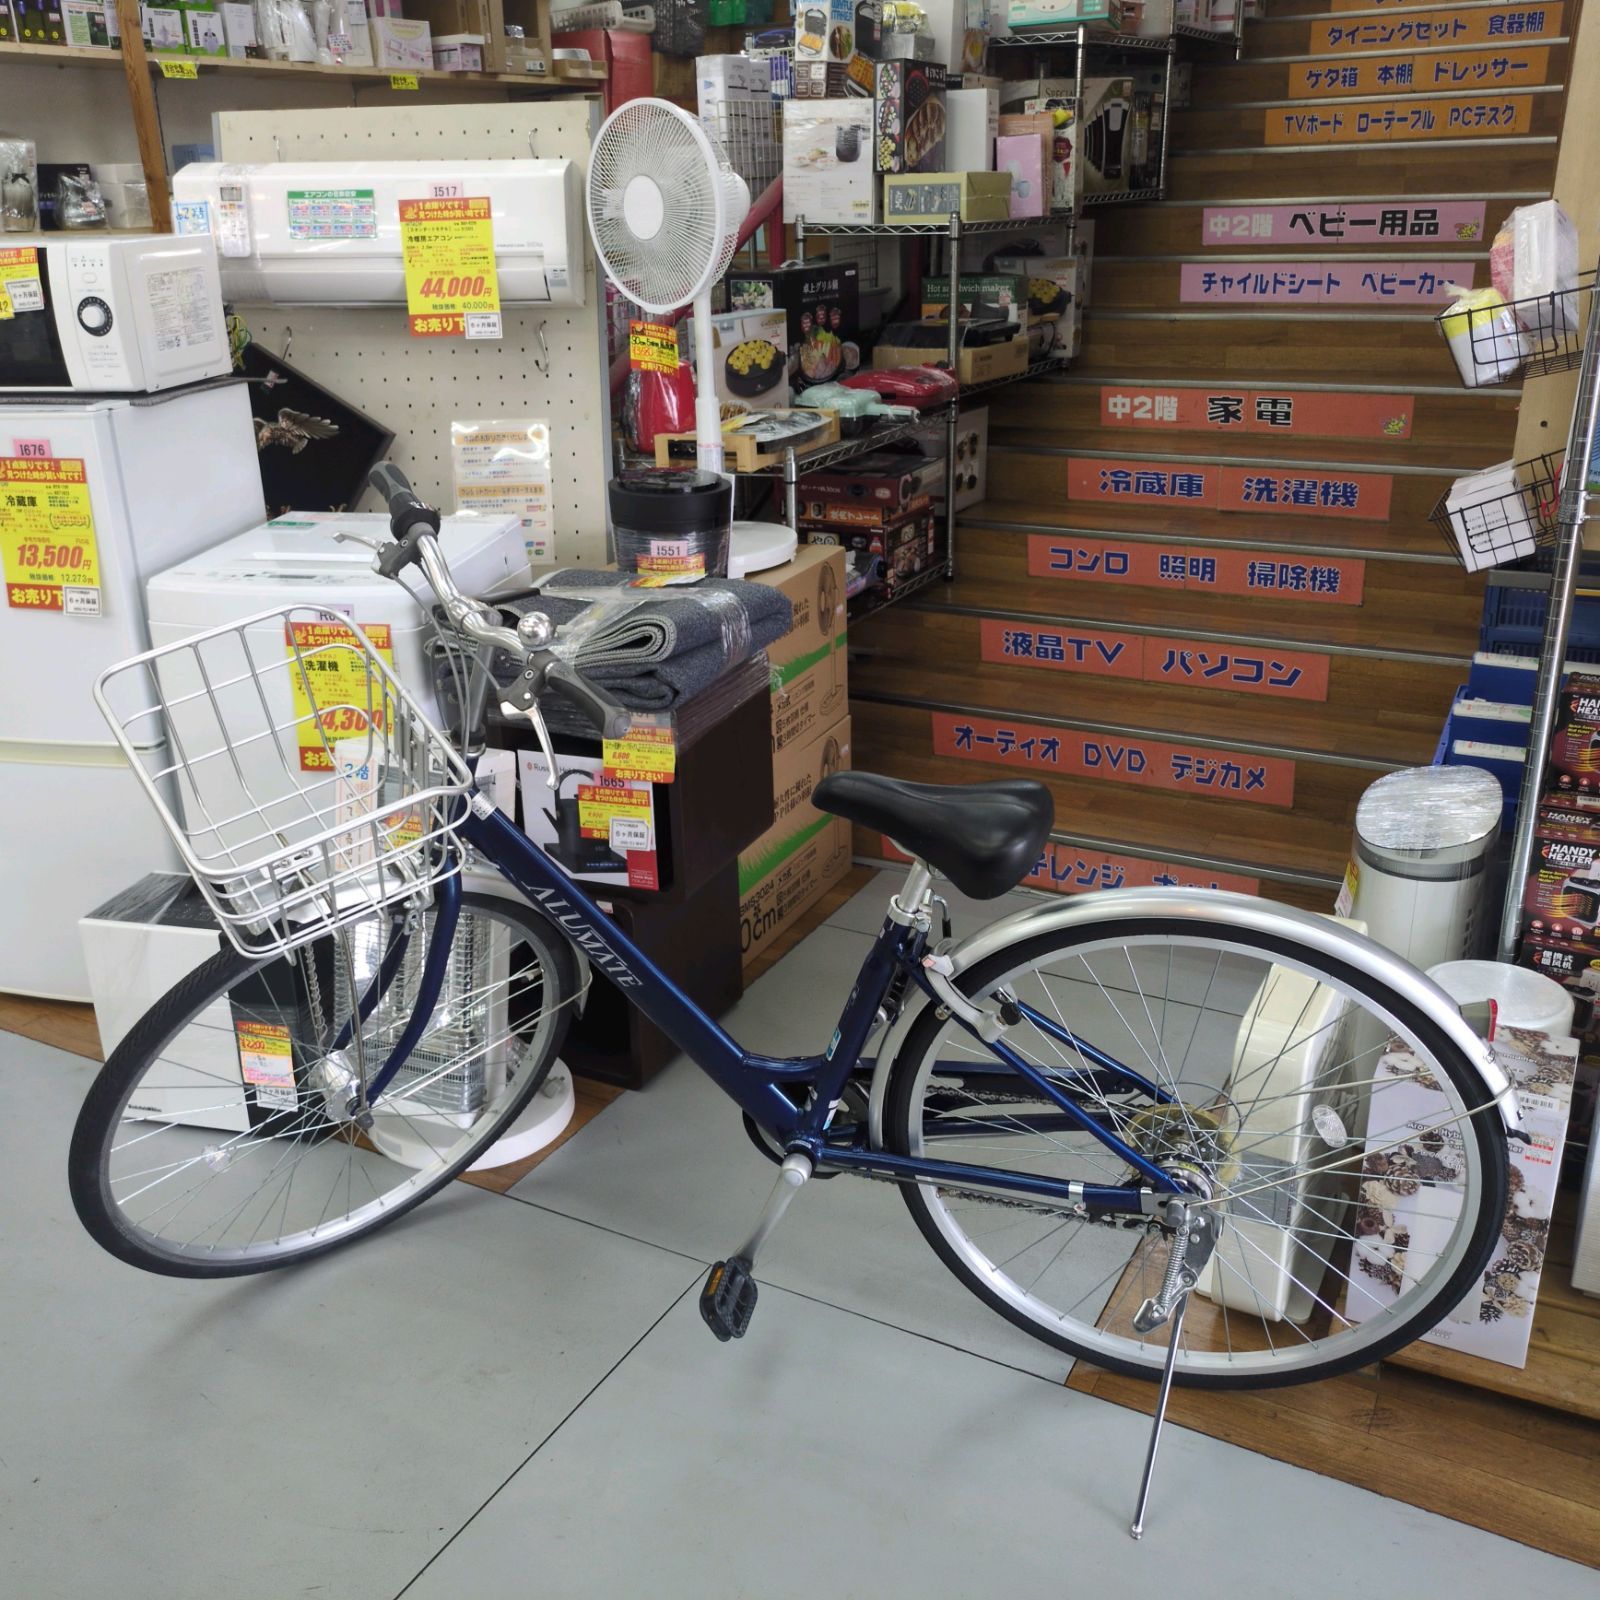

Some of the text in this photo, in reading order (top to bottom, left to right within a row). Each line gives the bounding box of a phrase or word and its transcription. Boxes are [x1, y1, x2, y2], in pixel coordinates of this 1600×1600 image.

[1487, 11, 1545, 36] 食器棚
[1305, 58, 1529, 89] ゲタ箱 本棚 ドレッサー
[1208, 209, 1439, 238] 中2階 ベビー用品
[419, 275, 493, 300] 44,000円
[927, 284, 941, 293] Hot
[1201, 271, 1341, 296] チャイルドシート
[1107, 394, 1294, 427] 中2階 家電
[5, 495, 38, 507] 冷蔵庫
[1099, 470, 1360, 508] 冷蔵庫 洗濯機
[17, 543, 92, 571] 13,500円
[1048, 546, 1341, 594] コンロ 照明 掃除機
[305, 660, 340, 672] 洗濯機
[1002, 630, 1303, 688] 液晶TV パソコン
[953, 724, 1267, 791] オーディオ DVD デジカメ
[1548, 852, 1593, 865] HEATER
[1550, 843, 1597, 858] HANDY
[520, 880, 644, 988] ALUMATE
